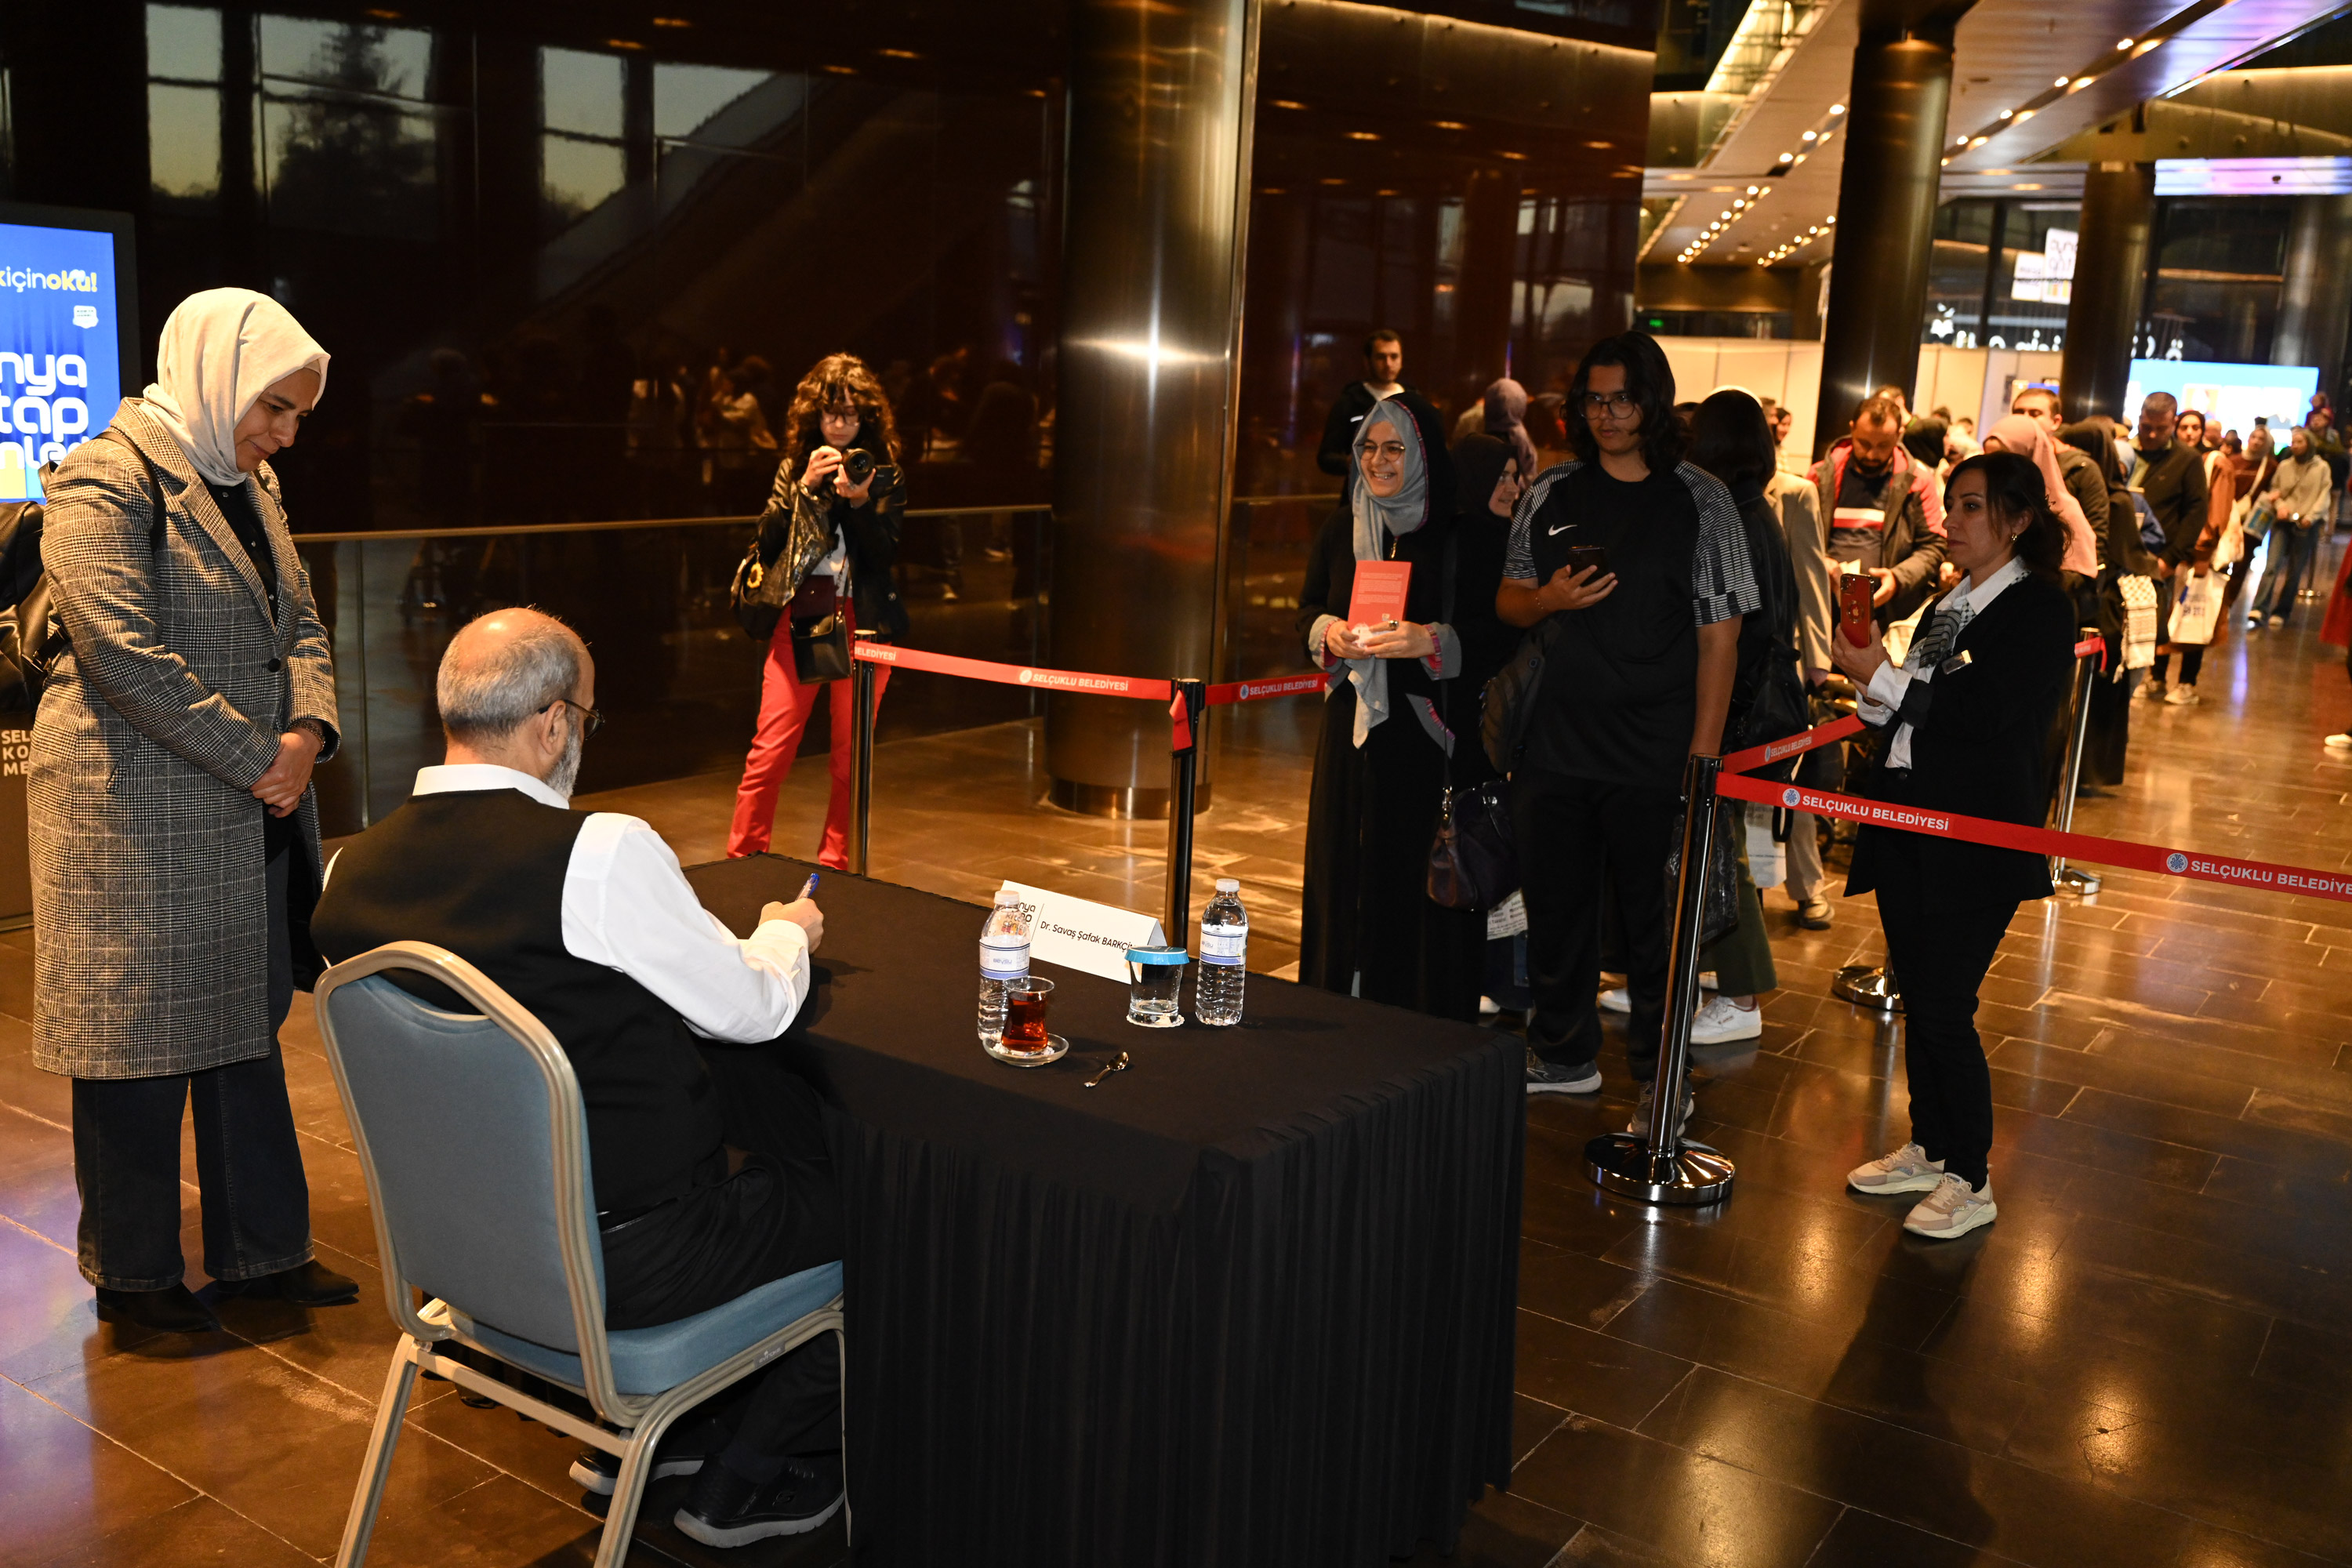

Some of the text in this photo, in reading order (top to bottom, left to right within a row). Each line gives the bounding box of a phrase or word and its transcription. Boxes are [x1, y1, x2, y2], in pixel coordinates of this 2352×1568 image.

[1033, 673, 1129, 691] SELÇUKLU BELEDİYESİ
[1250, 678, 1319, 696] SELÇUKLU BELEDİYESİ
[1, 729, 34, 745] SEL
[1802, 795, 1950, 831] SELÇUKLU BELEDİYESİ
[2190, 860, 2352, 895] SELÇUKLU BELEDİYE
[1040, 920, 1051, 931] Dr.
[1052, 924, 1076, 939] Savaş
[1077, 931, 1101, 944] Şafak
[1102, 937, 1135, 953] BARKÇİ
